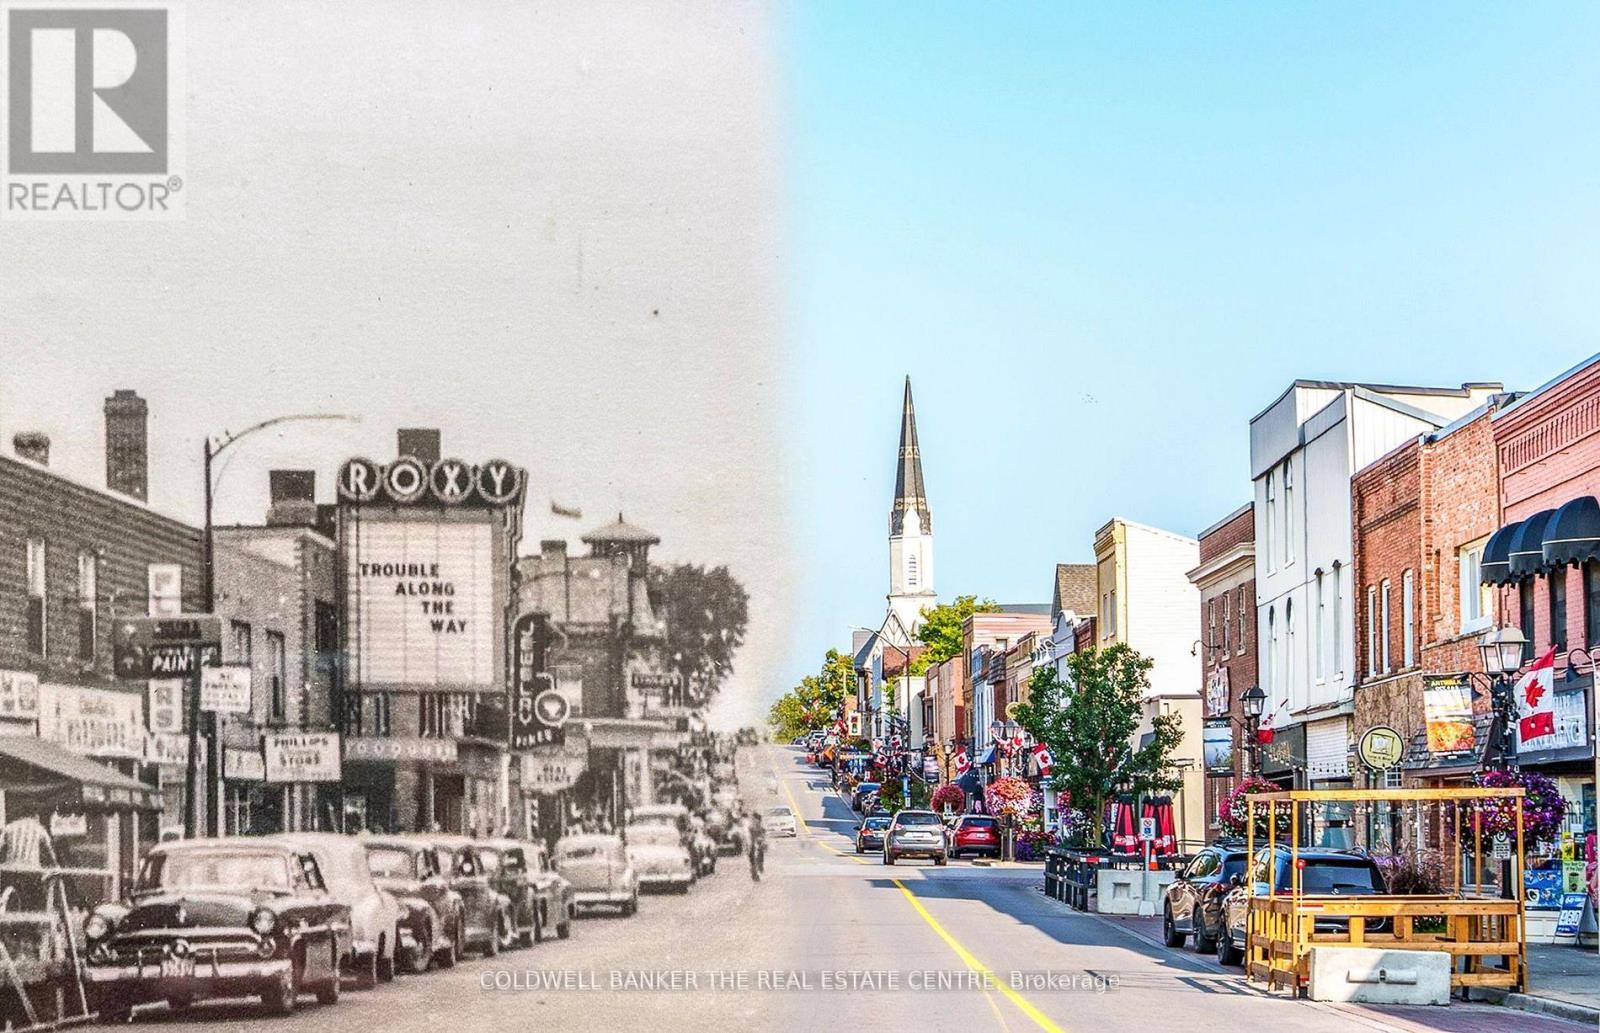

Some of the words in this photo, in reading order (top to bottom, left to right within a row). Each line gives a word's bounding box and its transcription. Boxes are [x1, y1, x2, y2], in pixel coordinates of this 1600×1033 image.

[350, 462, 507, 496] ROXY
[360, 563, 439, 577] TROUBLE
[395, 582, 455, 596] ALONG
[422, 601, 453, 614] THE
[431, 619, 467, 633] WAY
